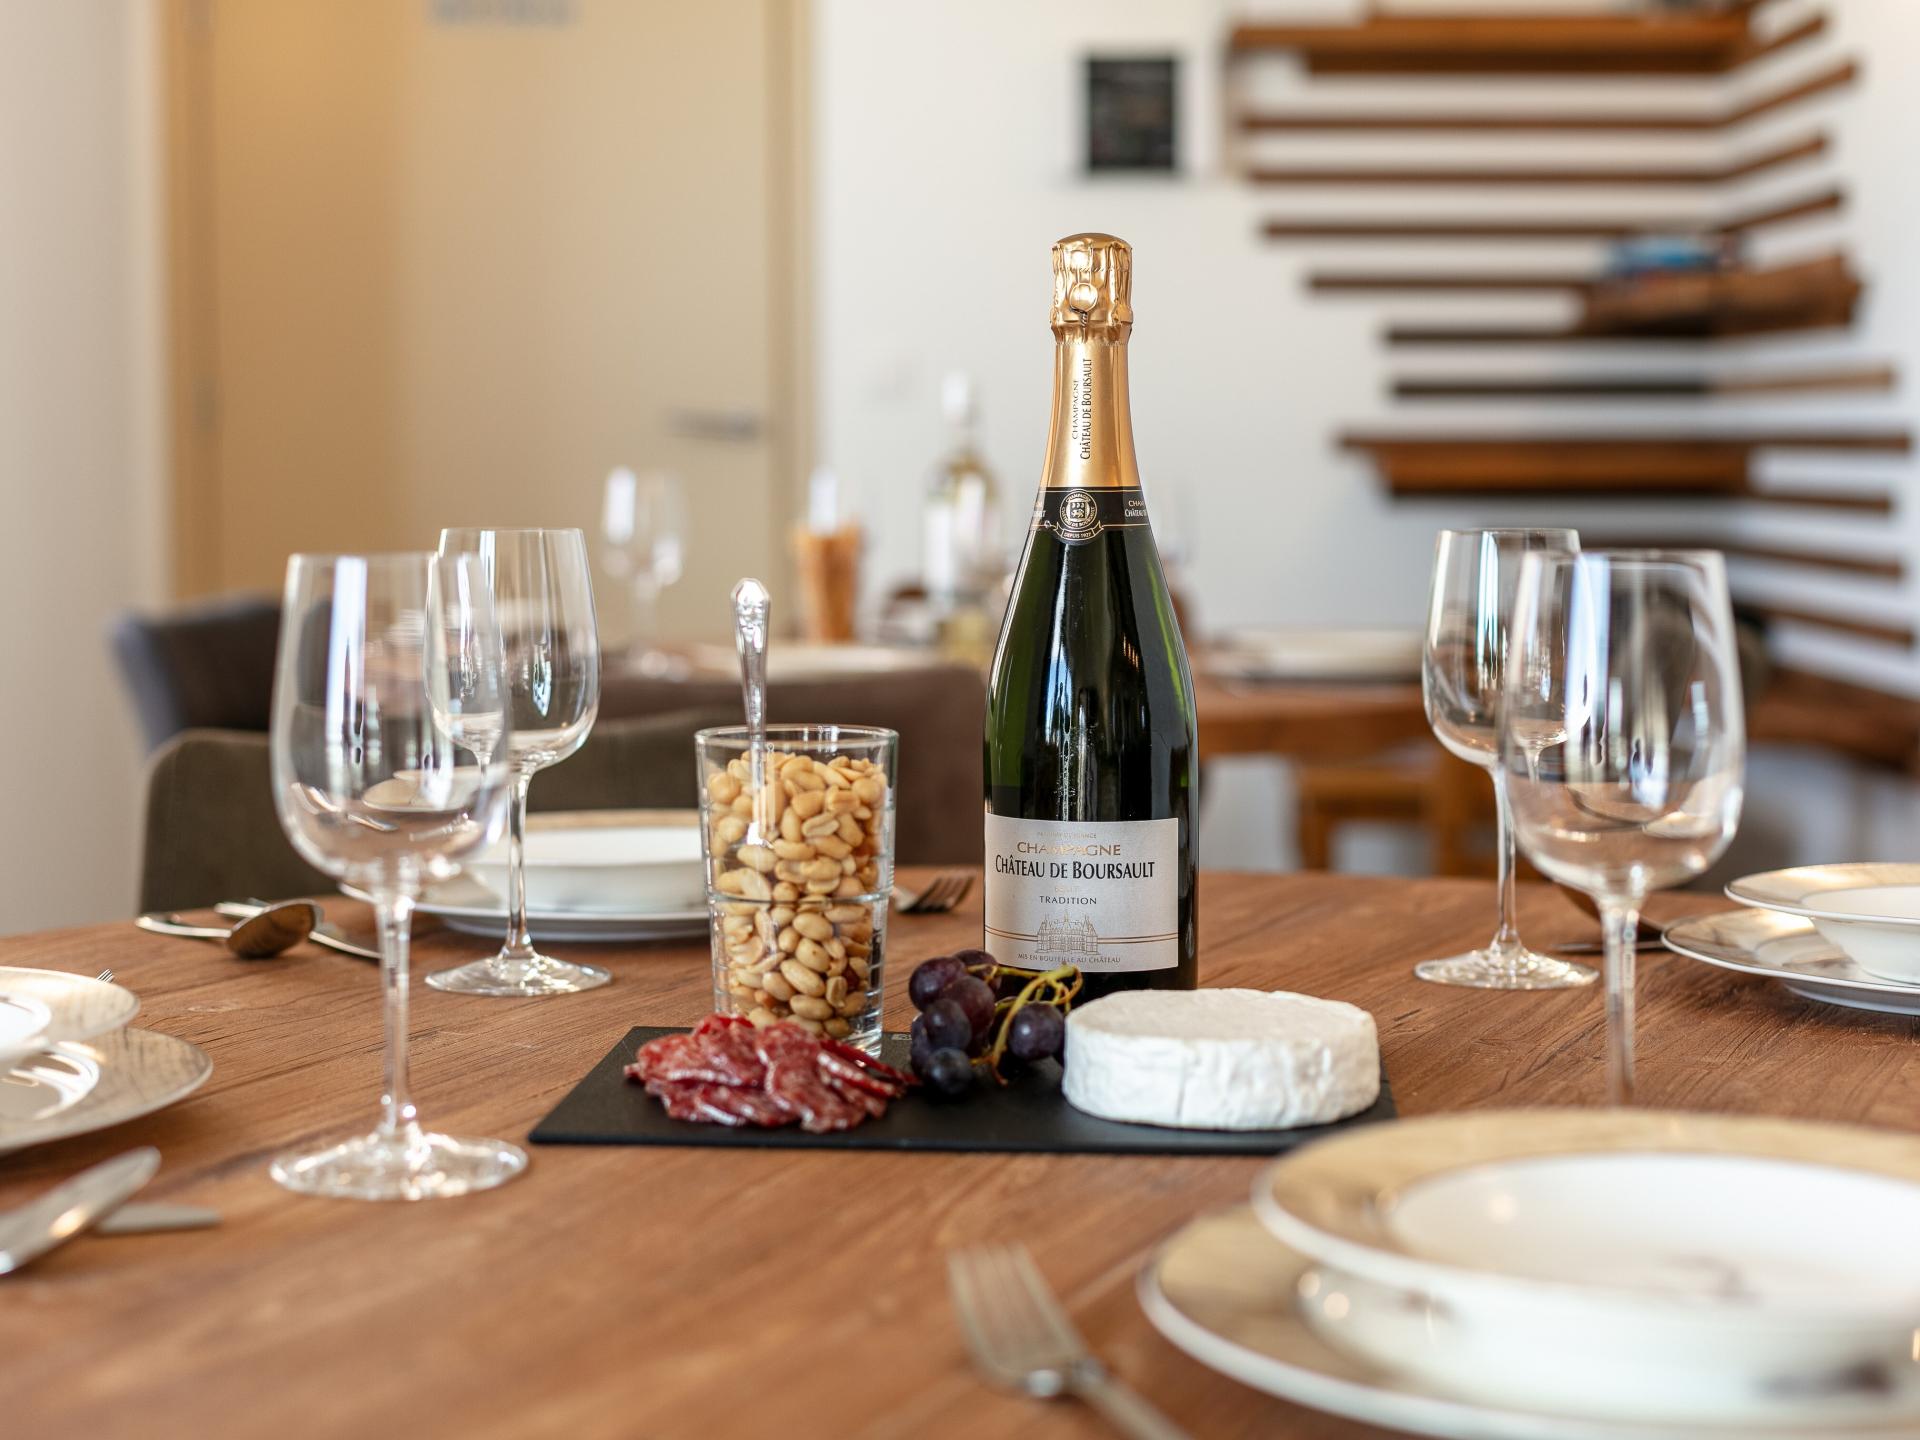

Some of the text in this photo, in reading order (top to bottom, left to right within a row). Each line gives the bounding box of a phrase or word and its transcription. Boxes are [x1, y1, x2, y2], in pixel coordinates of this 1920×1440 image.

[1071, 379, 1079, 440] CHAMPAGNE
[1079, 358, 1092, 460] CHÂTEAU DE BOURSAULT
[1016, 841, 1121, 856] CHAMPAGNE
[995, 854, 1155, 879] CHÂTEAU DE BOURSAULT
[1039, 895, 1097, 905] TRADITION
[1039, 955, 1075, 963] BOUTEILLE
[1076, 956, 1087, 964] AU
[1088, 955, 1121, 964] CHÂTEAU
